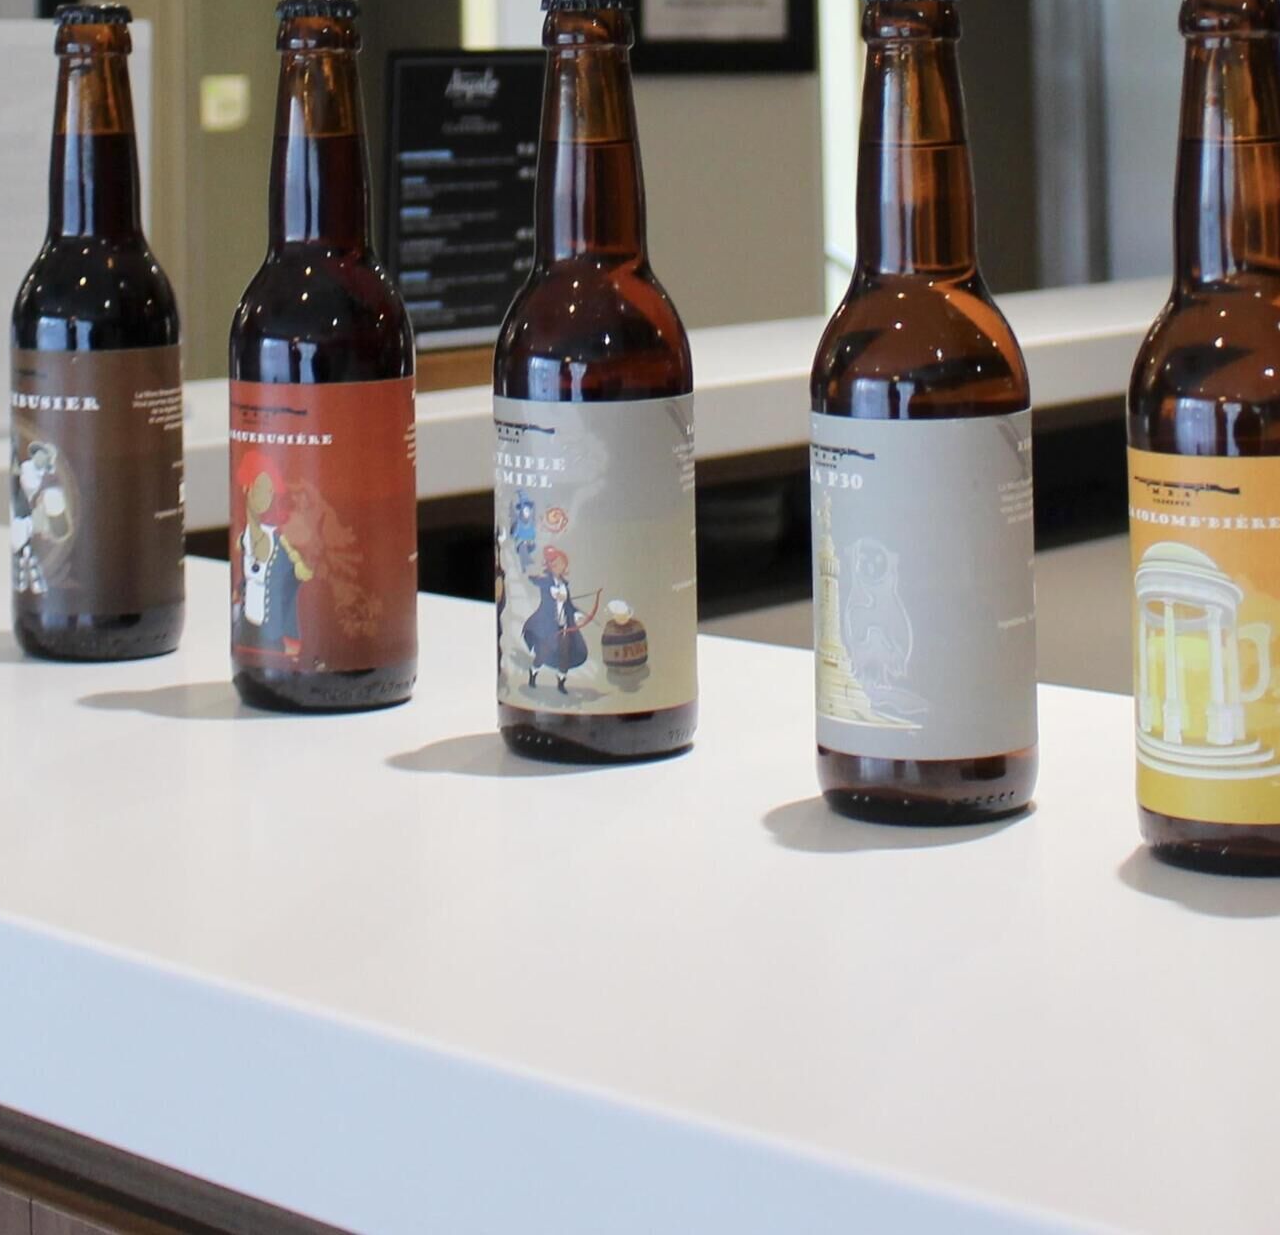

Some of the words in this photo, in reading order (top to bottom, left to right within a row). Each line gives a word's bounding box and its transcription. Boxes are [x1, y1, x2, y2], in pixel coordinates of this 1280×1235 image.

[496, 451, 566, 471] TRIPLE
[502, 470, 553, 489] MIEL
[827, 470, 864, 490] P30
